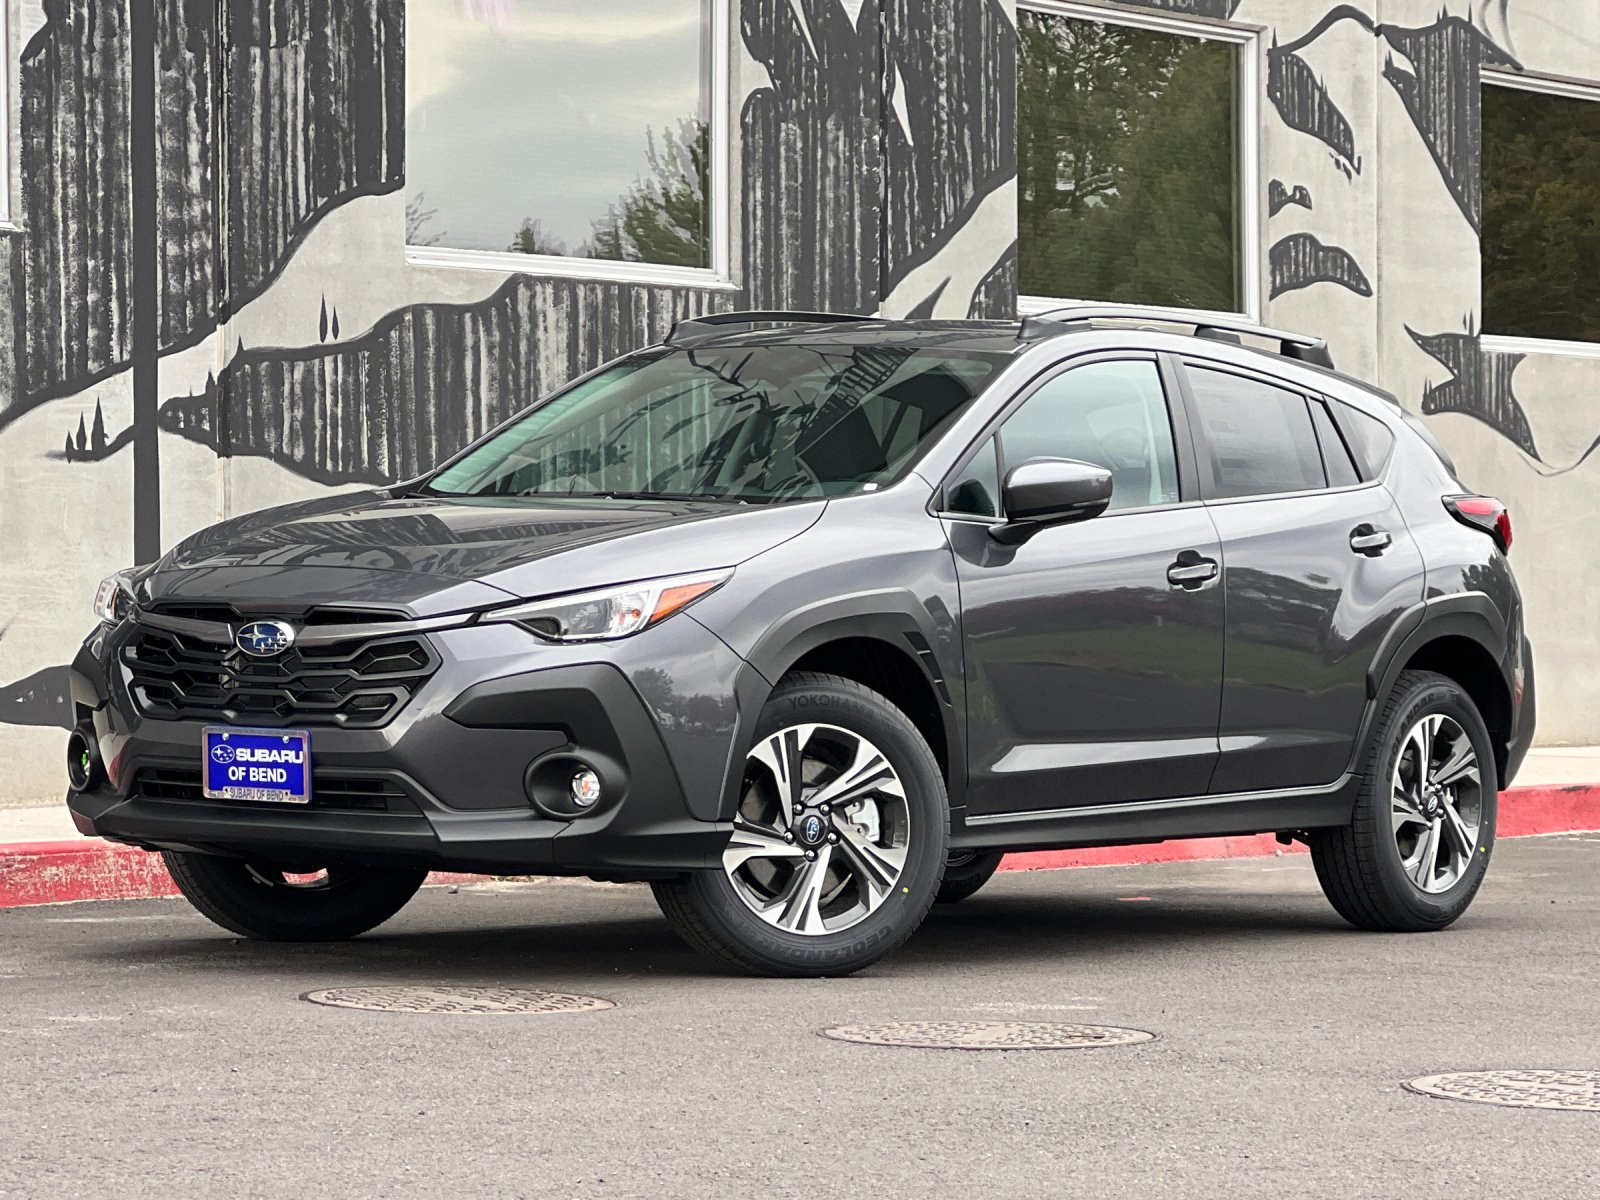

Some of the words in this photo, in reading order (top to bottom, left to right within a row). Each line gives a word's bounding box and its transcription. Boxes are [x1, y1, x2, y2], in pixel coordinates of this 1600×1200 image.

[235, 748, 304, 764] SUBARU
[228, 766, 246, 781] OF
[249, 767, 287, 783] BEND
[229, 787, 255, 799] SUBARU
[256, 789, 265, 800] OF
[266, 790, 284, 801] BEND
